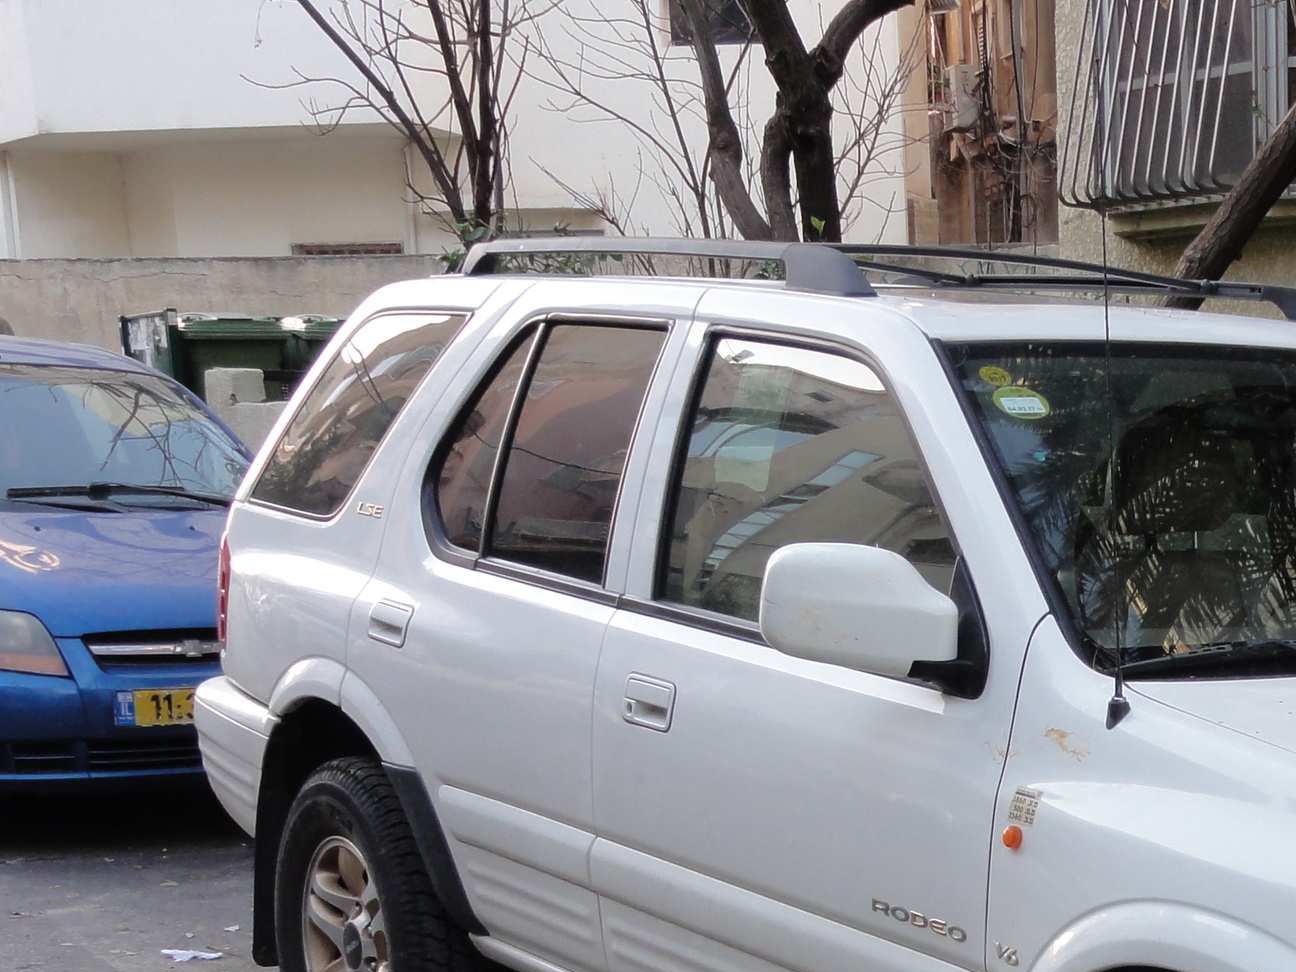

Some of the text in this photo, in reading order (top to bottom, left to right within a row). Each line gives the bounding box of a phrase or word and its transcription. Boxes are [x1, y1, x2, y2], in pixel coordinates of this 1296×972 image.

[356, 501, 385, 520] LSE
[121, 702, 133, 716] IL
[871, 897, 968, 943] RODEO
[993, 940, 1019, 967] V6
